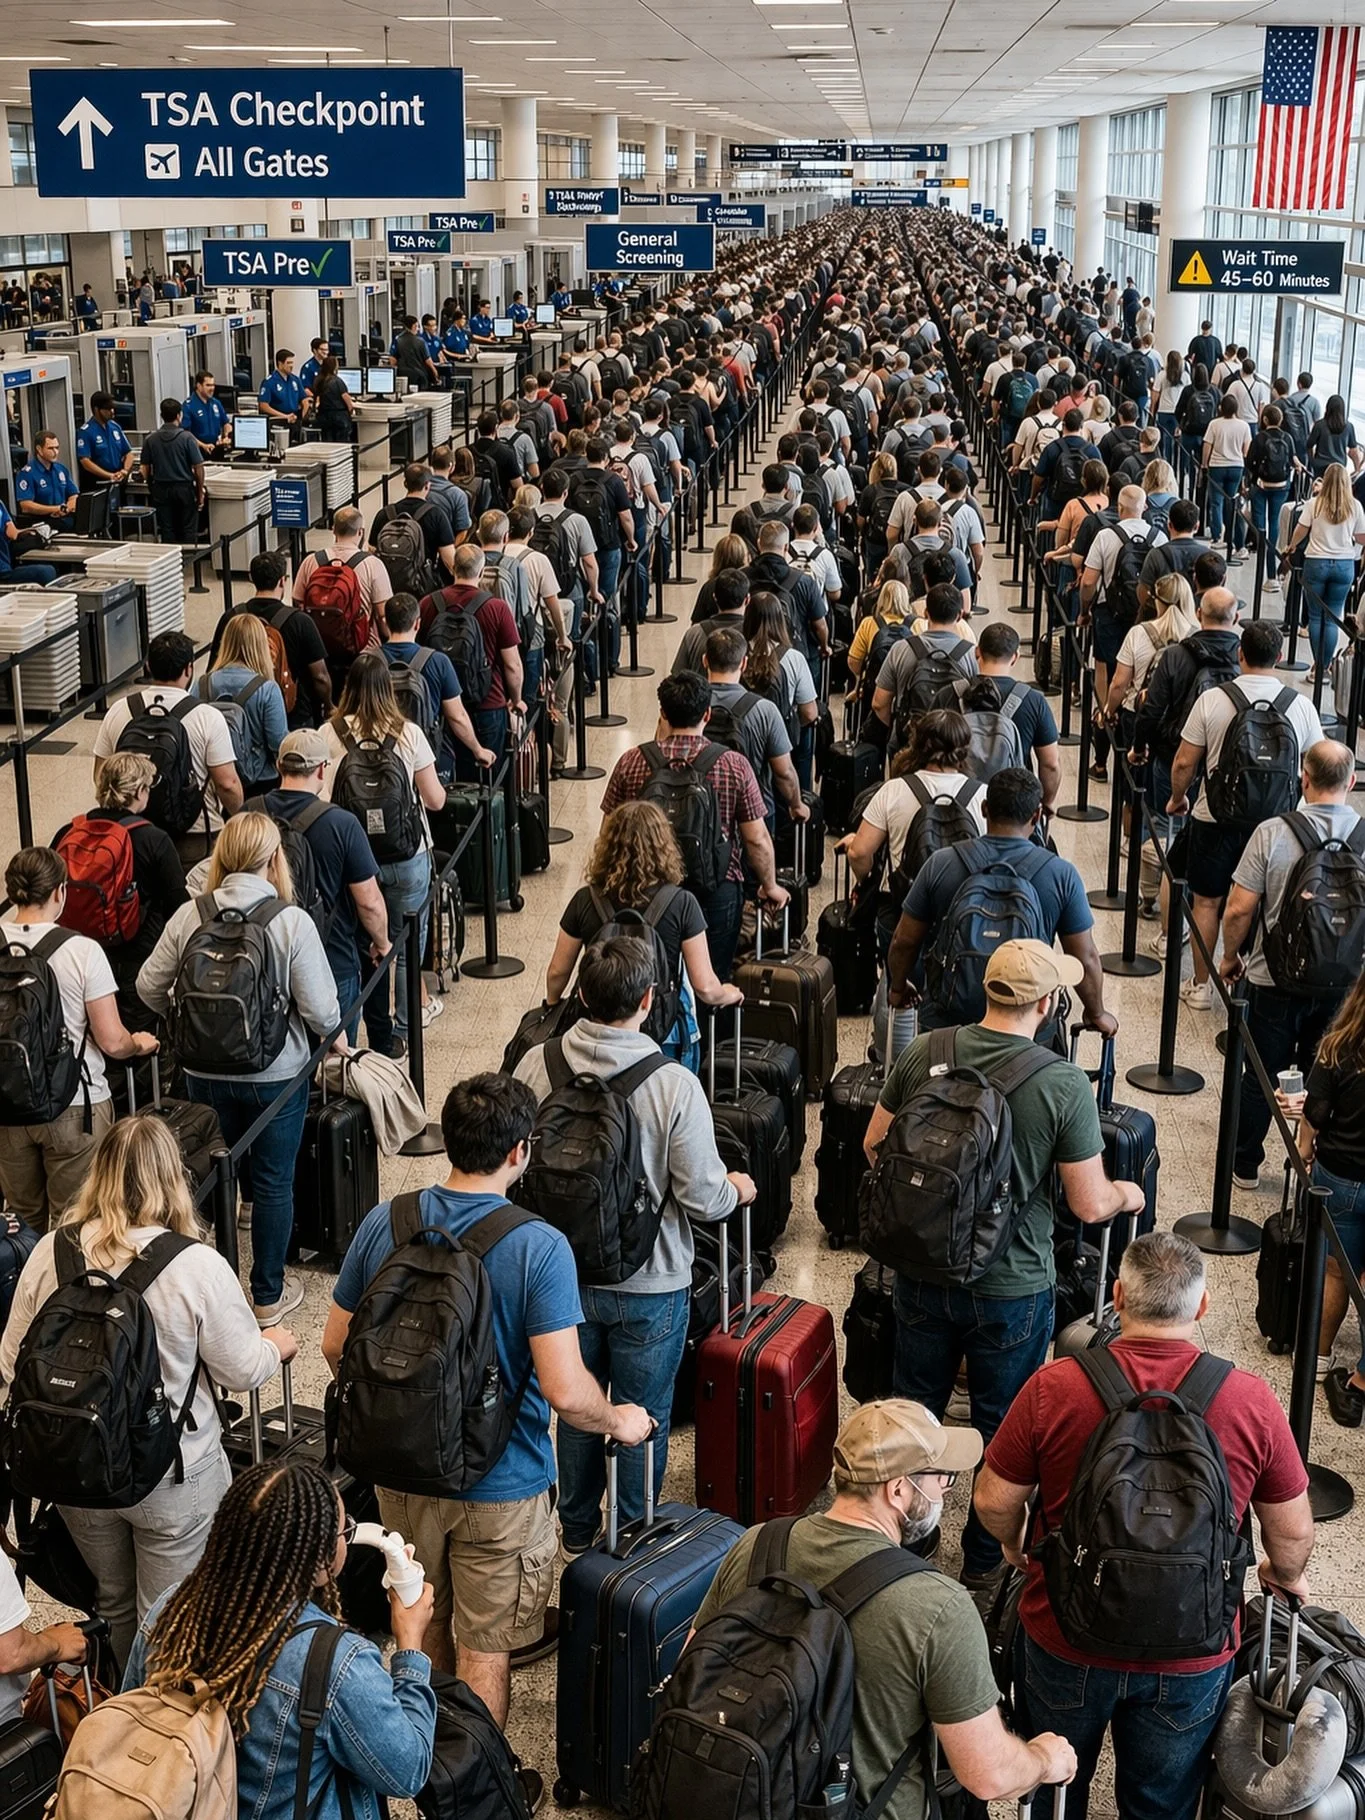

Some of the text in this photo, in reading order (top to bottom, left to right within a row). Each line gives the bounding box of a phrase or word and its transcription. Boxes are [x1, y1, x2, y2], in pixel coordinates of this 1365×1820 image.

[141, 91, 425, 134] TSA Checkpoint
[194, 146, 329, 177] All Gates
[435, 216, 458, 229] TSA
[393, 235, 416, 248] TSA
[617, 231, 677, 247] General
[223, 251, 310, 276] TSA Pre
[616, 249, 684, 267] Screening
[1222, 250, 1298, 266] Wait Time
[1279, 273, 1330, 288] Minutes
